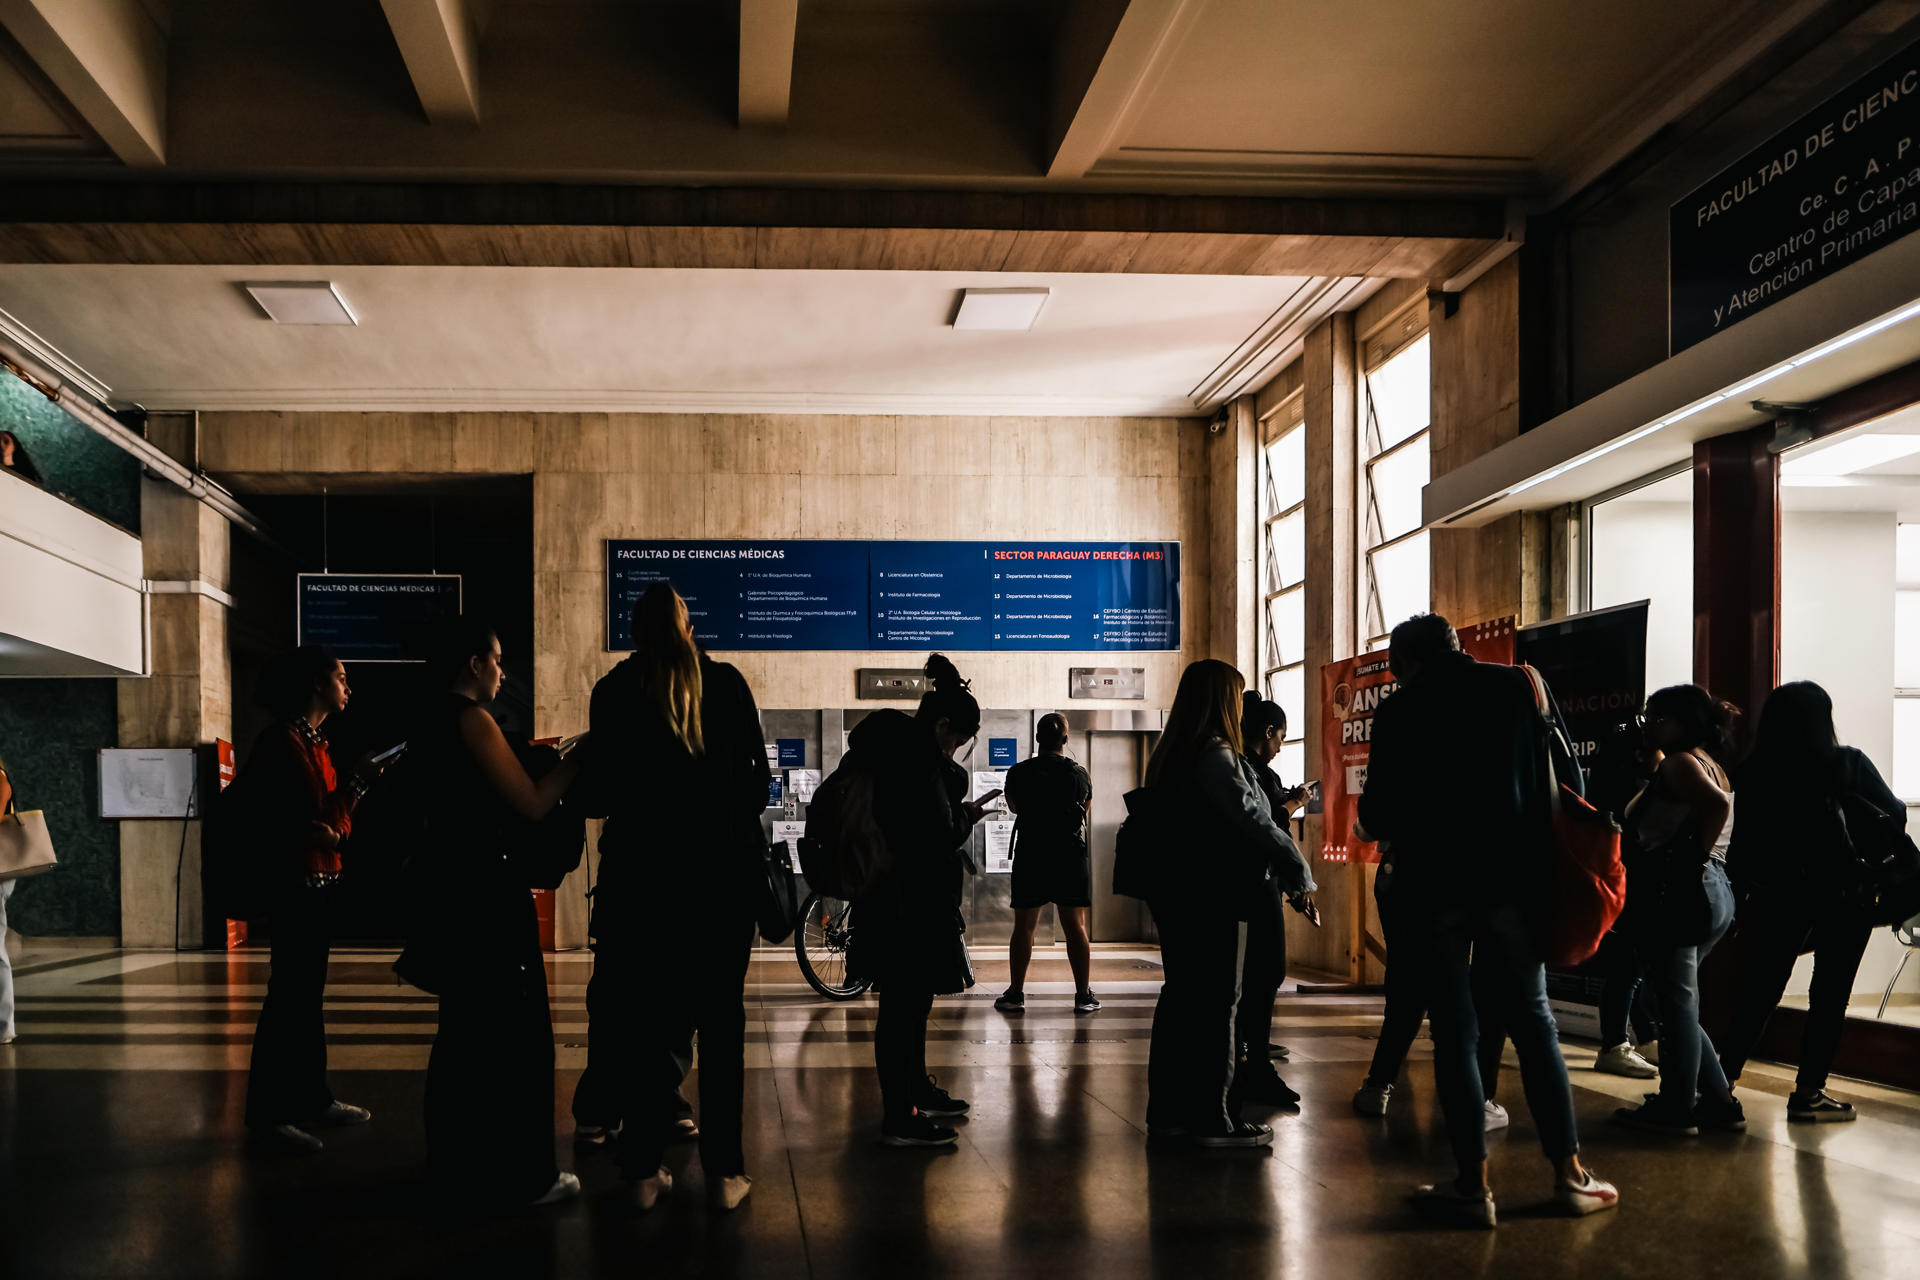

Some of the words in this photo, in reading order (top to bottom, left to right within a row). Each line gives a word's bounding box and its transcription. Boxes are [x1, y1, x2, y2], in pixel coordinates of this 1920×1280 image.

[1697, 148, 1798, 228] FACULTAD
[1805, 122, 1835, 159] DE
[1842, 70, 1917, 133] CIENC
[1713, 306, 1725, 327] y
[1728, 258, 1814, 316] Atención
[1821, 201, 1918, 266] Primaria
[1748, 226, 1816, 275] Centro
[1823, 206, 1850, 236] de
[617, 550, 670, 559] FACULTAD
[672, 550, 686, 559] DE
[688, 550, 737, 559] CIENCIAS
[738, 548, 785, 559] MÉDICAS
[994, 551, 1035, 560] SECTOR
[1037, 551, 1091, 560] PARAGUAY
[1093, 551, 1141, 560] DERECHA
[1142, 551, 1164, 560] (M3)
